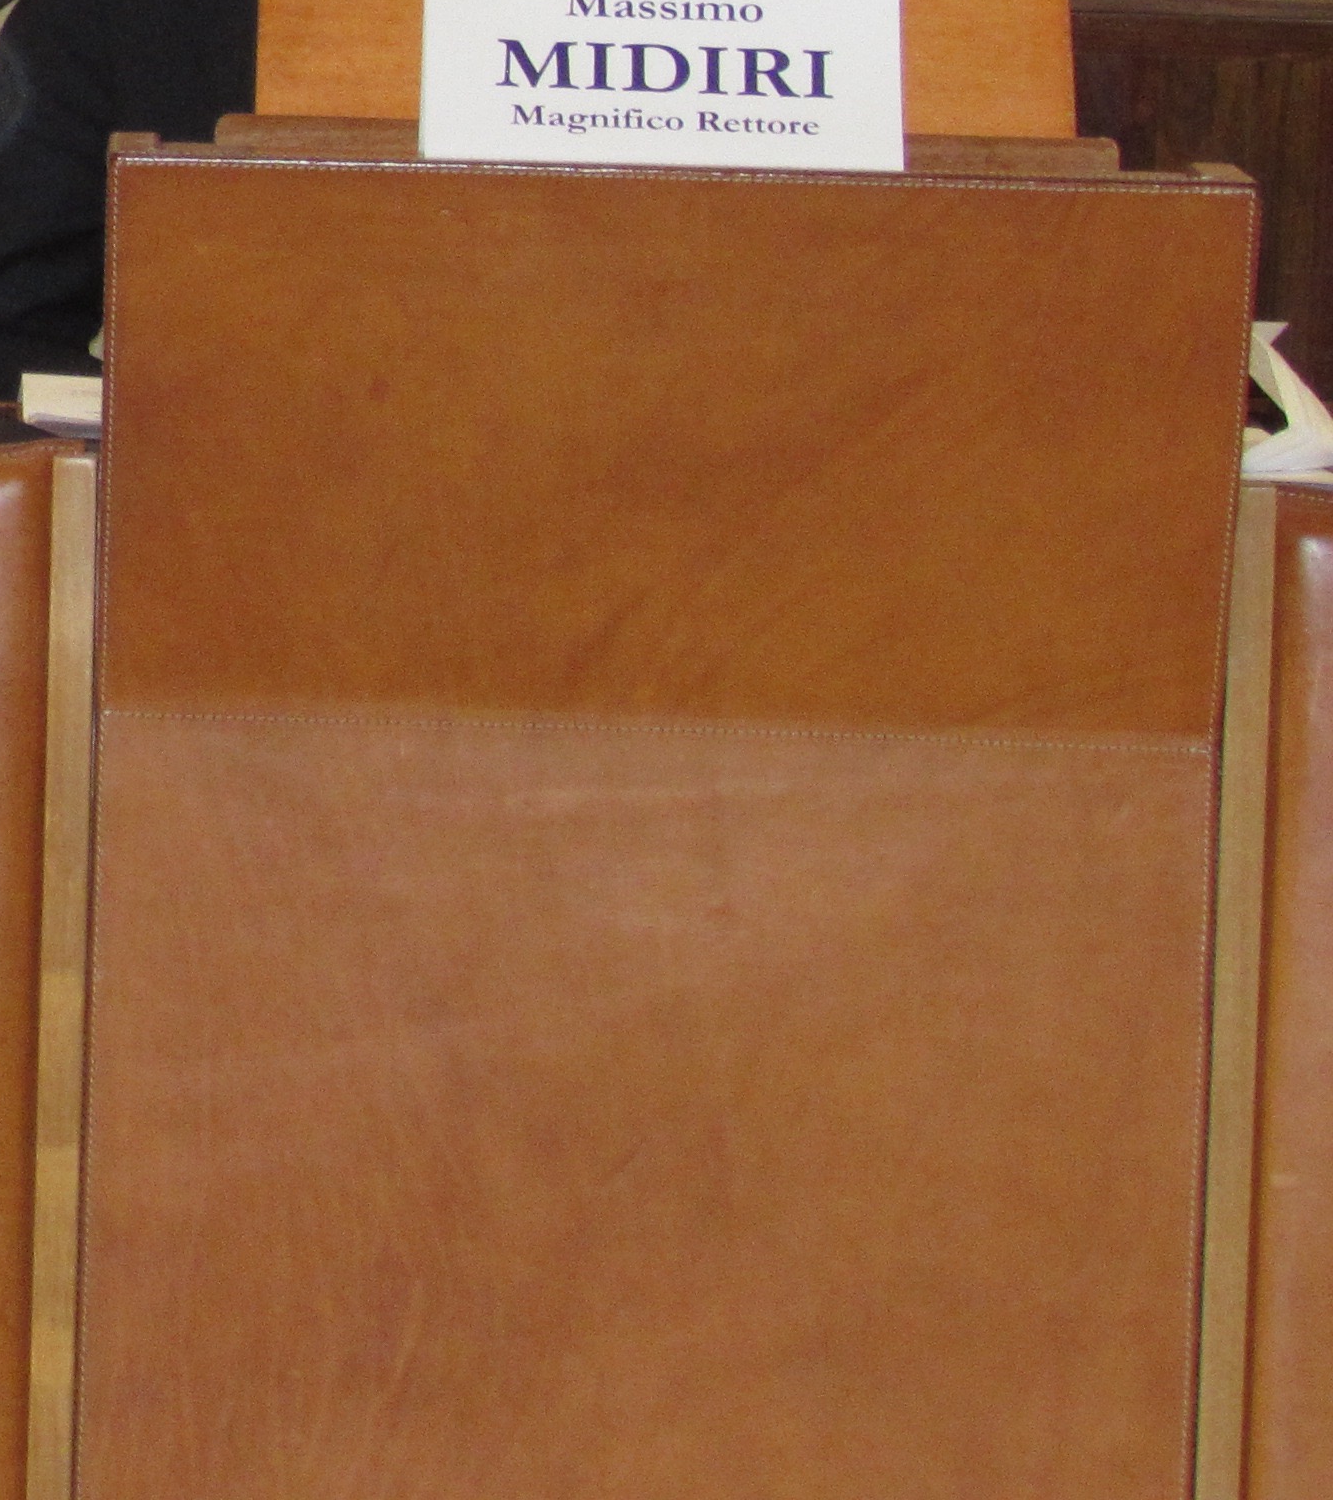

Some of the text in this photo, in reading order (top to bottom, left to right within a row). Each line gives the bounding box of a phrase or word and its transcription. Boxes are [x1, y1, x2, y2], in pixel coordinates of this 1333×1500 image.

[495, 37, 835, 99] MIDIRI
[511, 103, 821, 137] Magnifico Rettore
